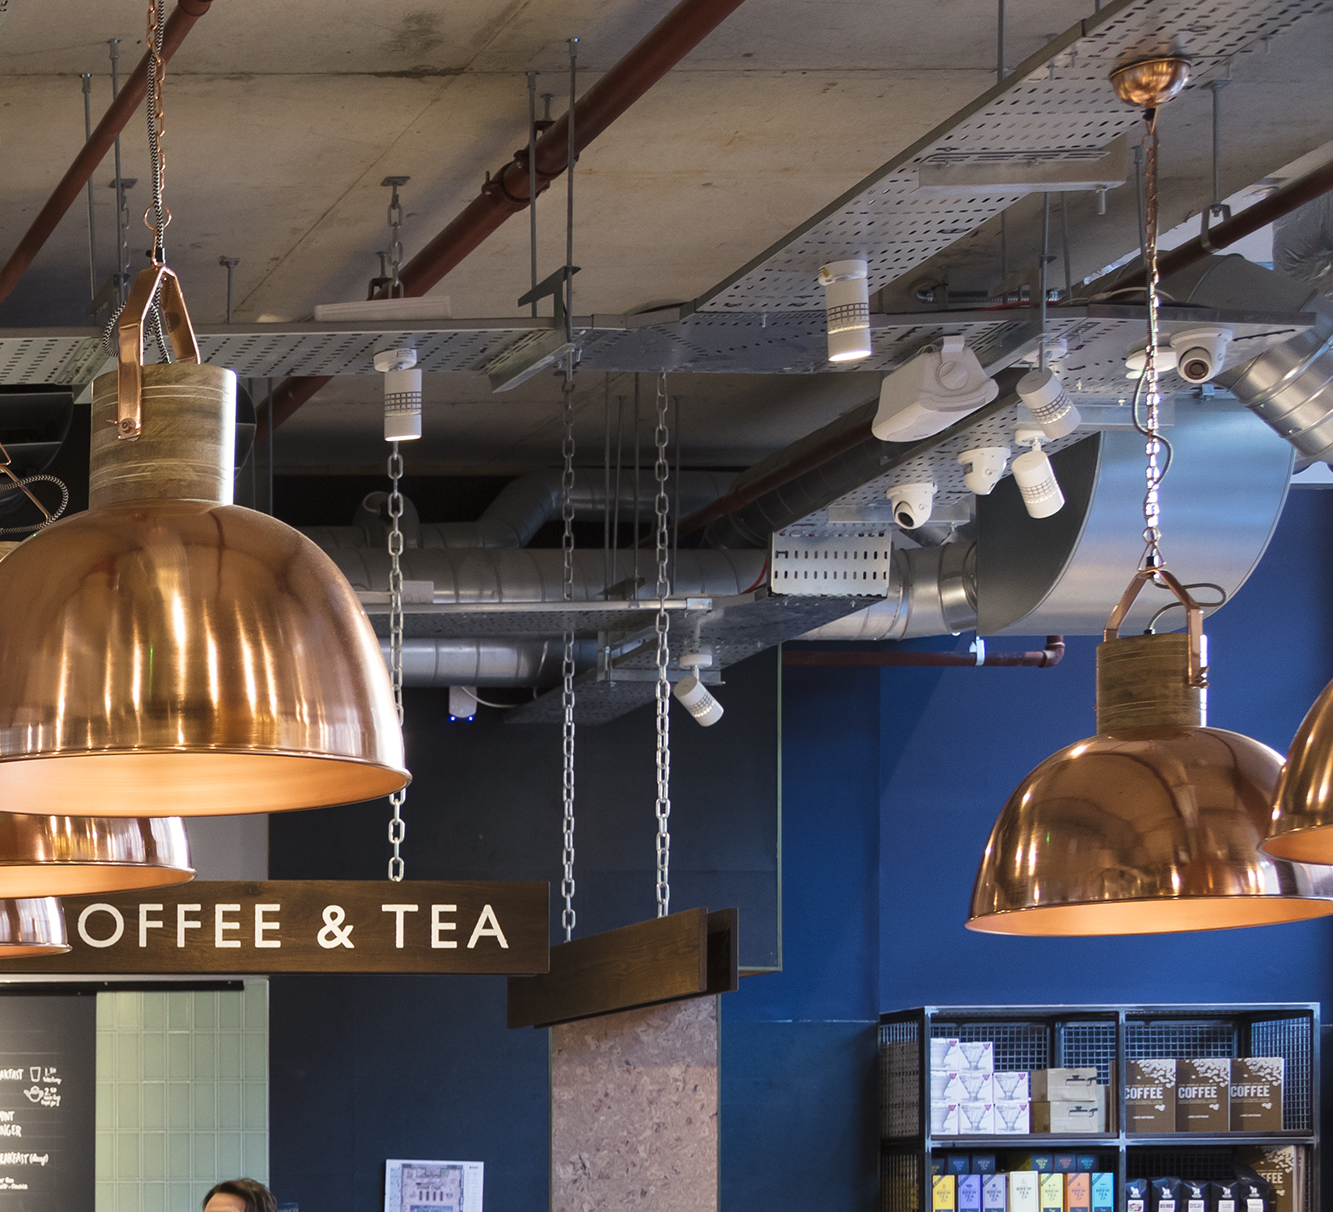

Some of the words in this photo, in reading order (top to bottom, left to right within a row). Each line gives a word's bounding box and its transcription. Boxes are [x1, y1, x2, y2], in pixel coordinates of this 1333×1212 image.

[77, 903, 282, 949] OFFEE
[315, 904, 356, 950] &
[381, 904, 509, 949] TEA
[1178, 1086, 1217, 1099] COFFEE
[1230, 1085, 1270, 1098] COFFEE
